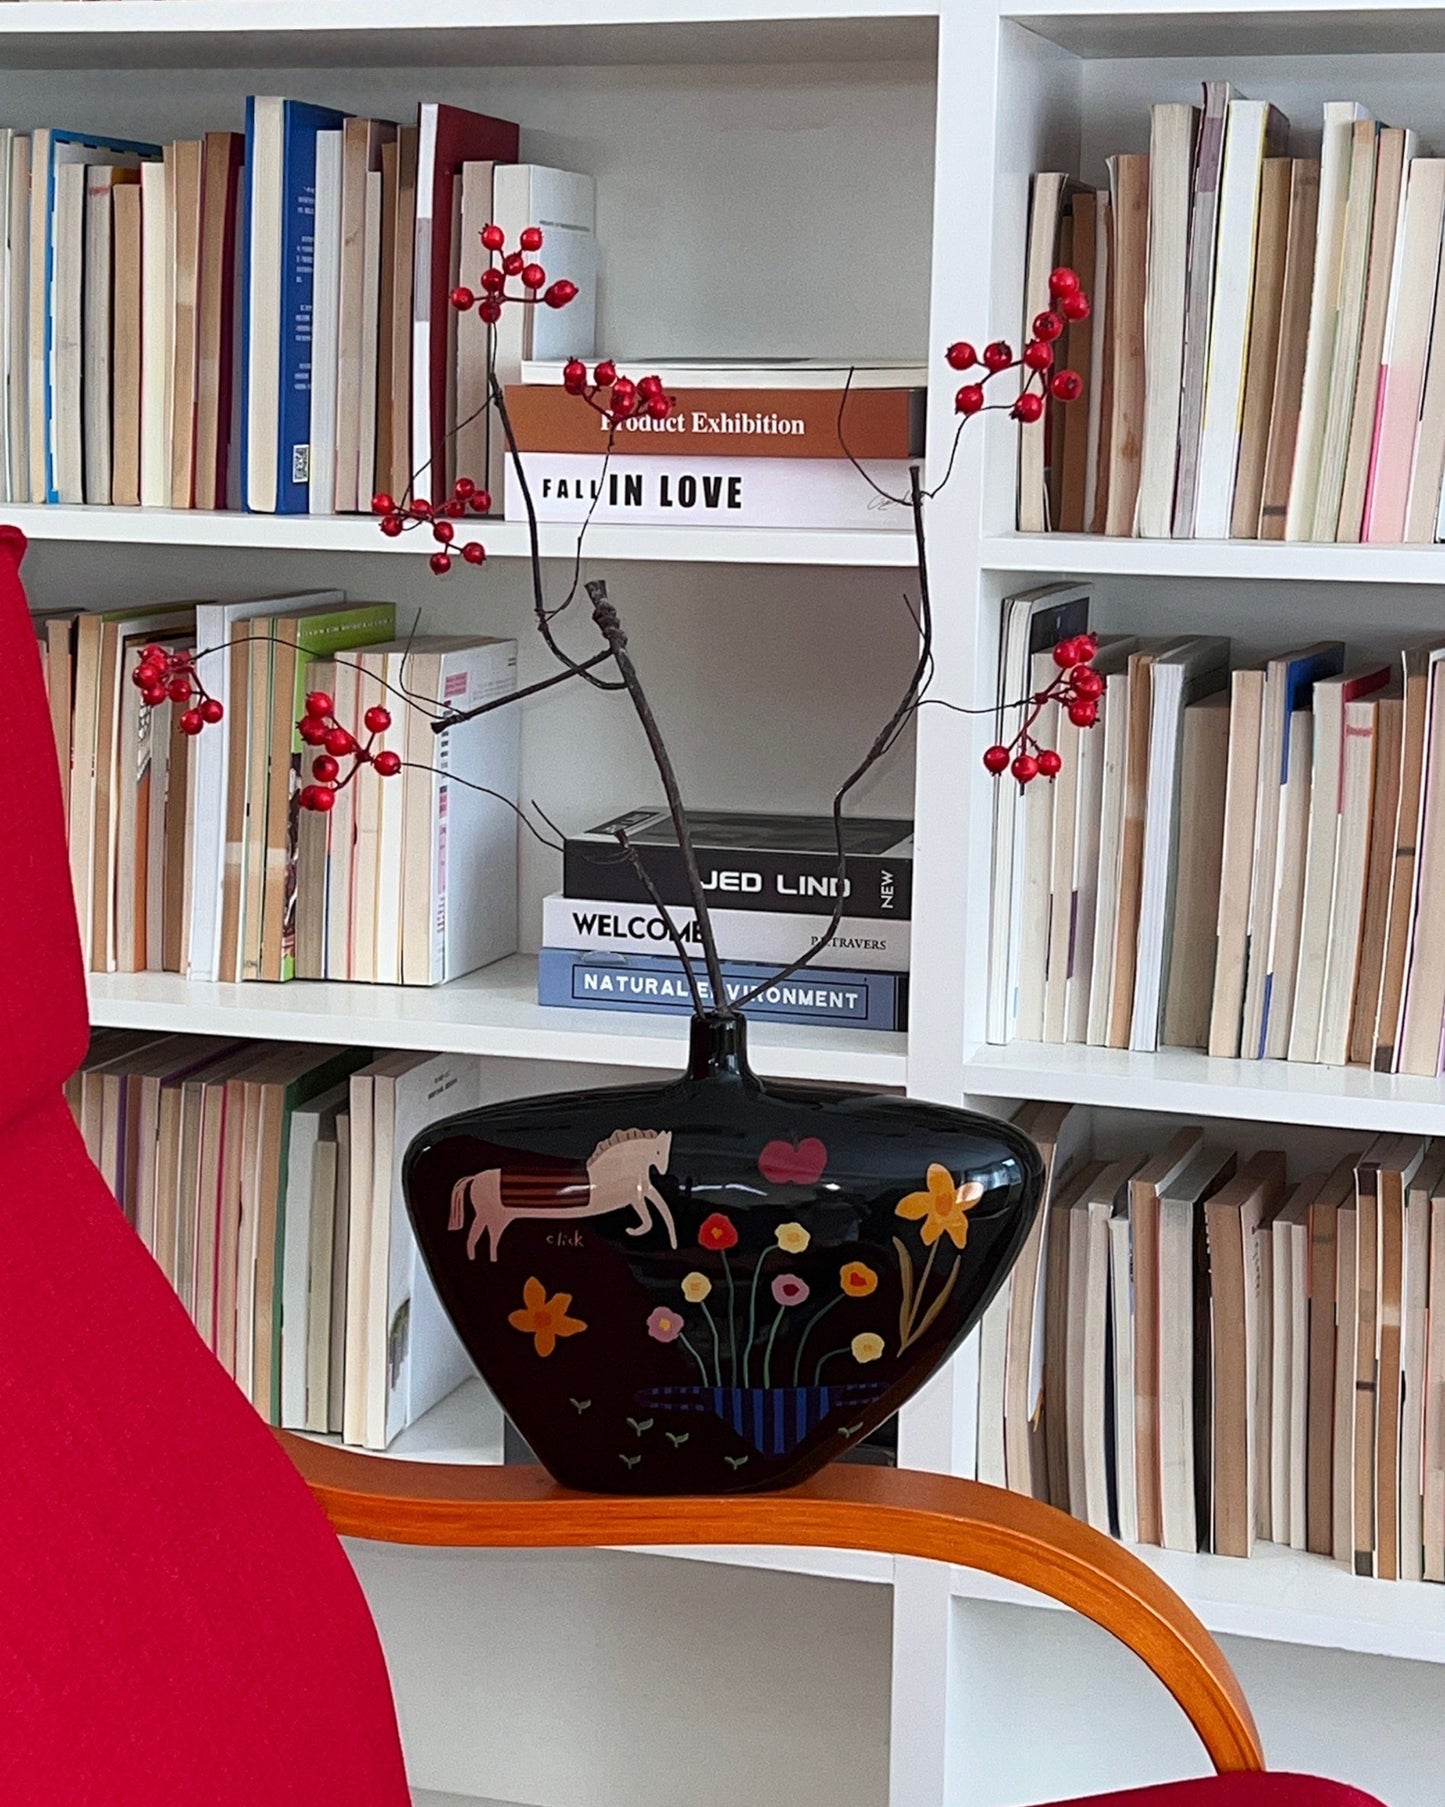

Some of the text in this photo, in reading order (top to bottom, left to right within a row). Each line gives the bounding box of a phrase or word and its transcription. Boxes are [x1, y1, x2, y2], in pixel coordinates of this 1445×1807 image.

[691, 412, 805, 435] Exhibition
[543, 474, 742, 509] FALL IN LOVE
[700, 870, 852, 898] JED LIND
[881, 869, 894, 909] NEW
[572, 912, 704, 943] WELCOME
[584, 973, 859, 1009] NATURAL EVIRONMENT
[546, 1229, 585, 1248] click
